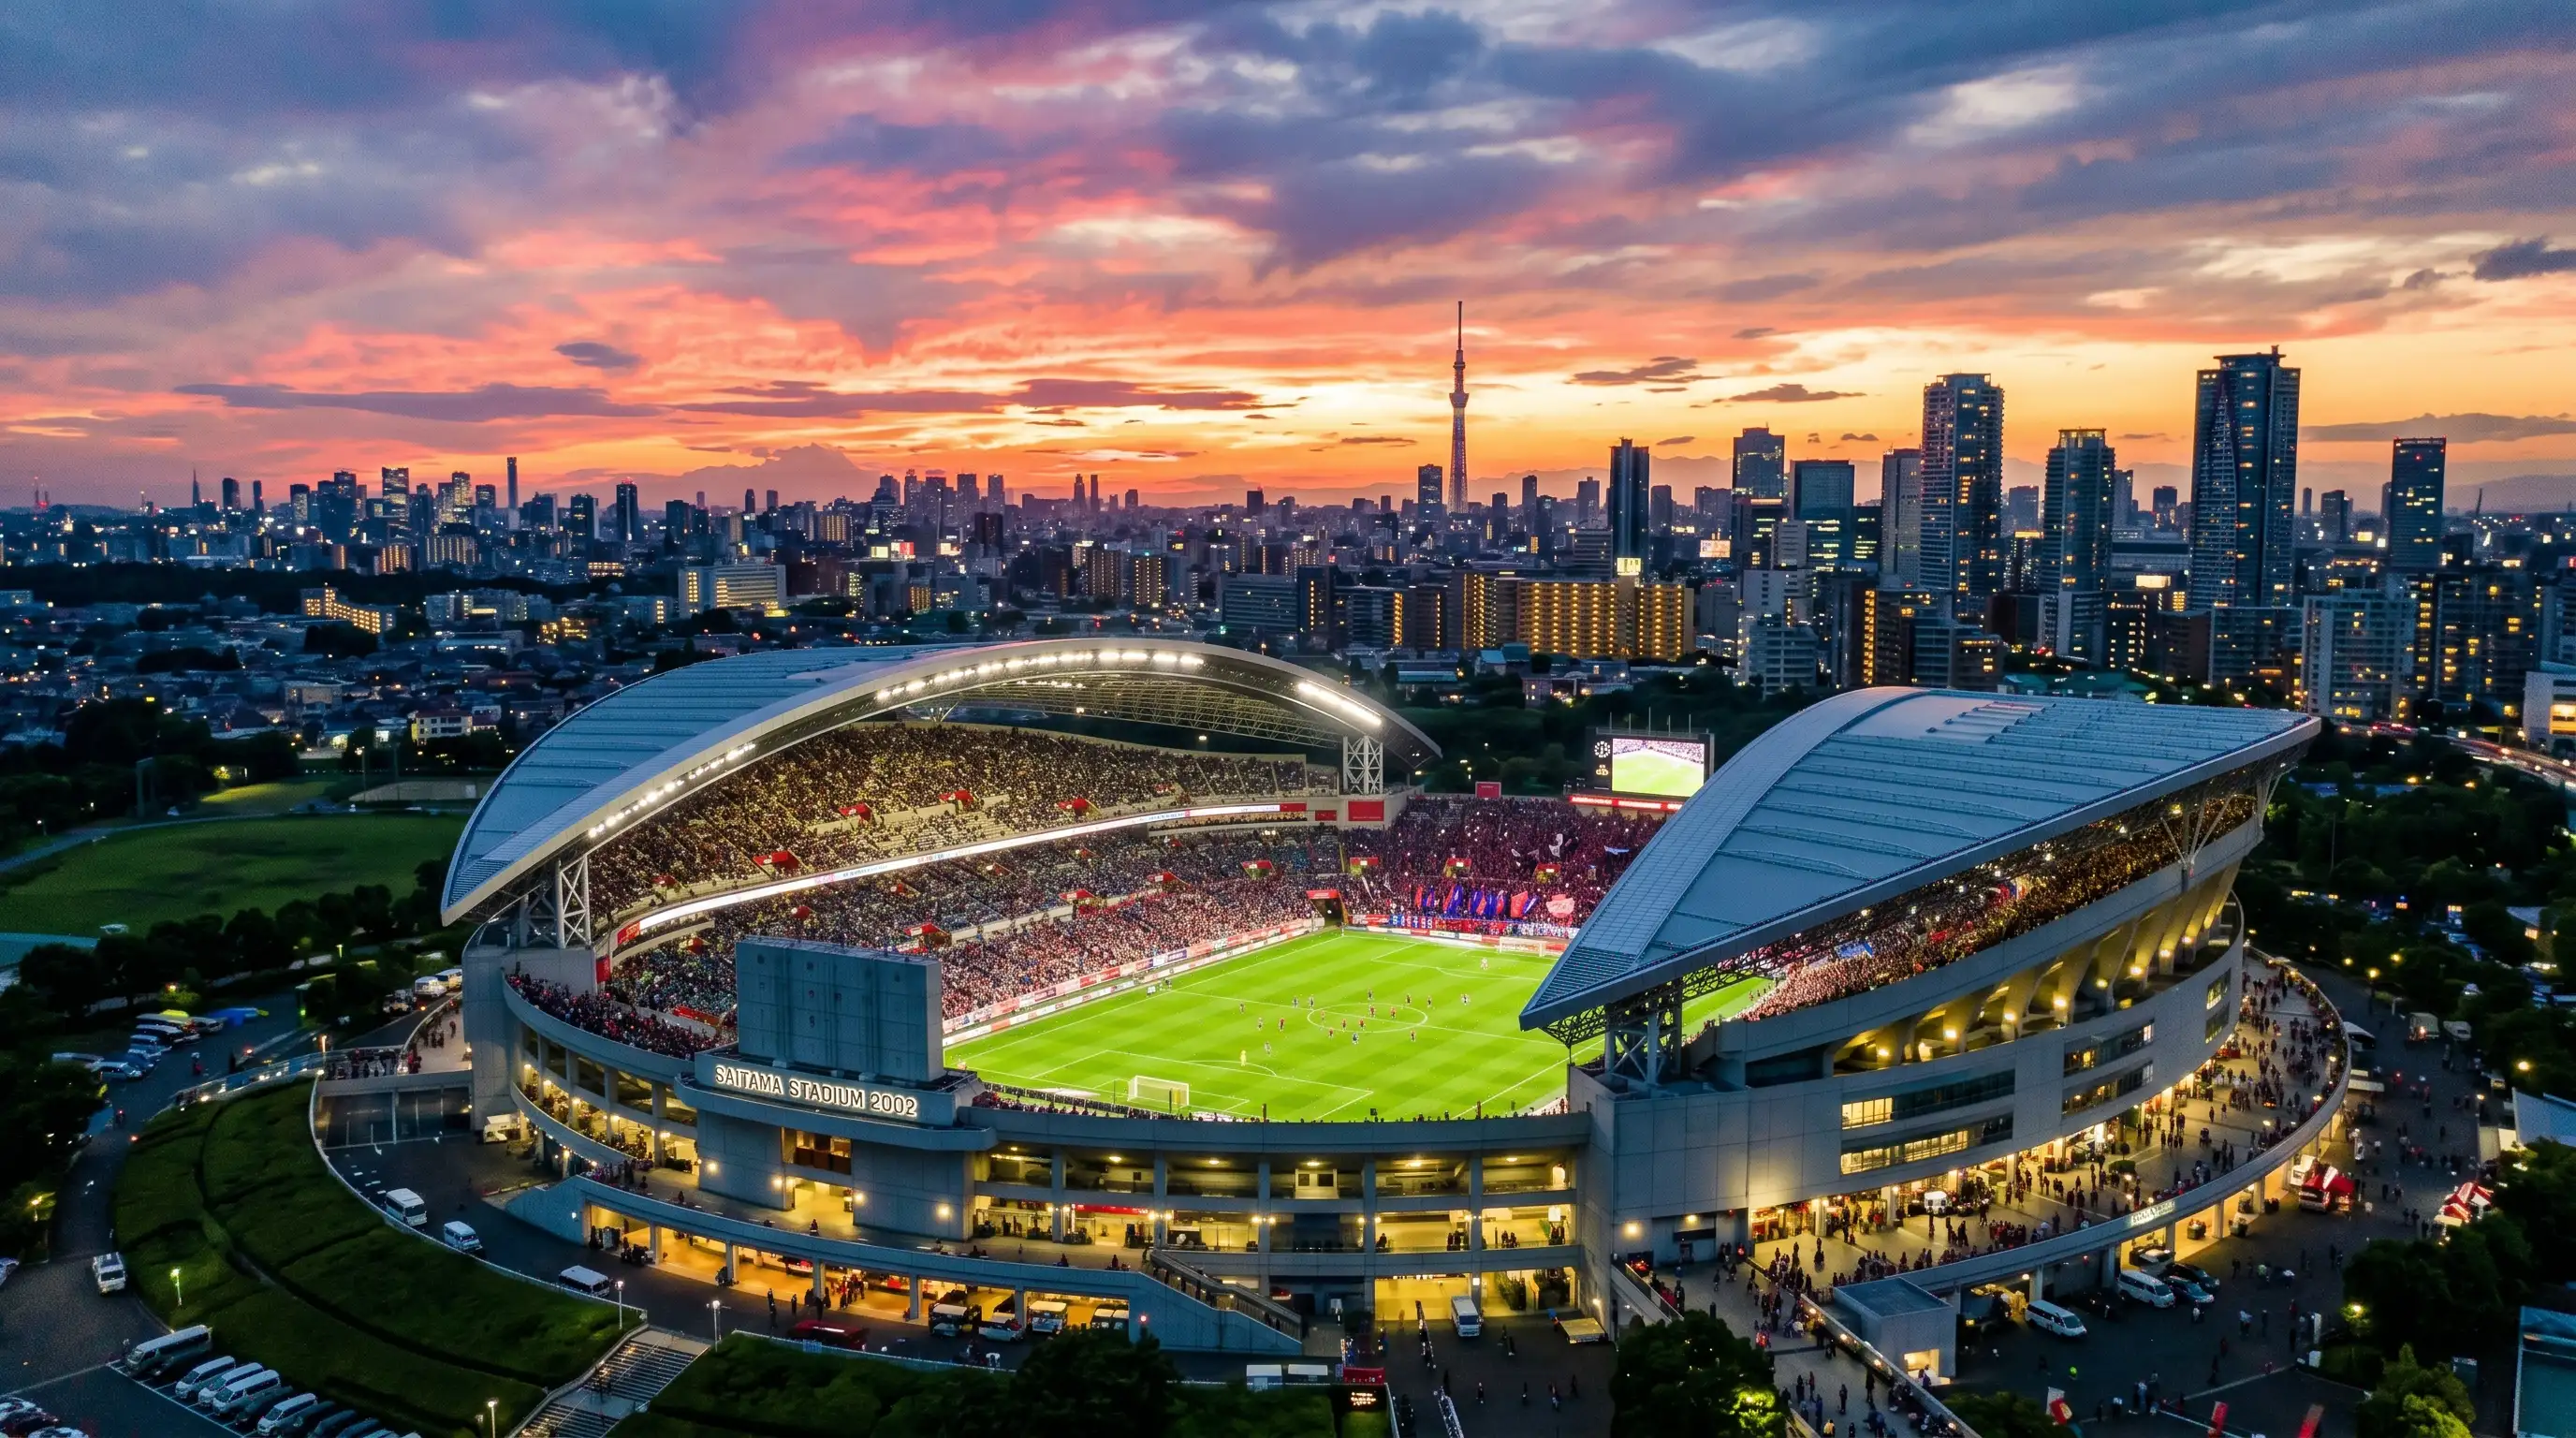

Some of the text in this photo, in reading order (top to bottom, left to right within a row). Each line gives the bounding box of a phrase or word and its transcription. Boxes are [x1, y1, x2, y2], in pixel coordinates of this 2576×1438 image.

[715, 1065, 917, 1116] SAITAMA STADIUM 2002
